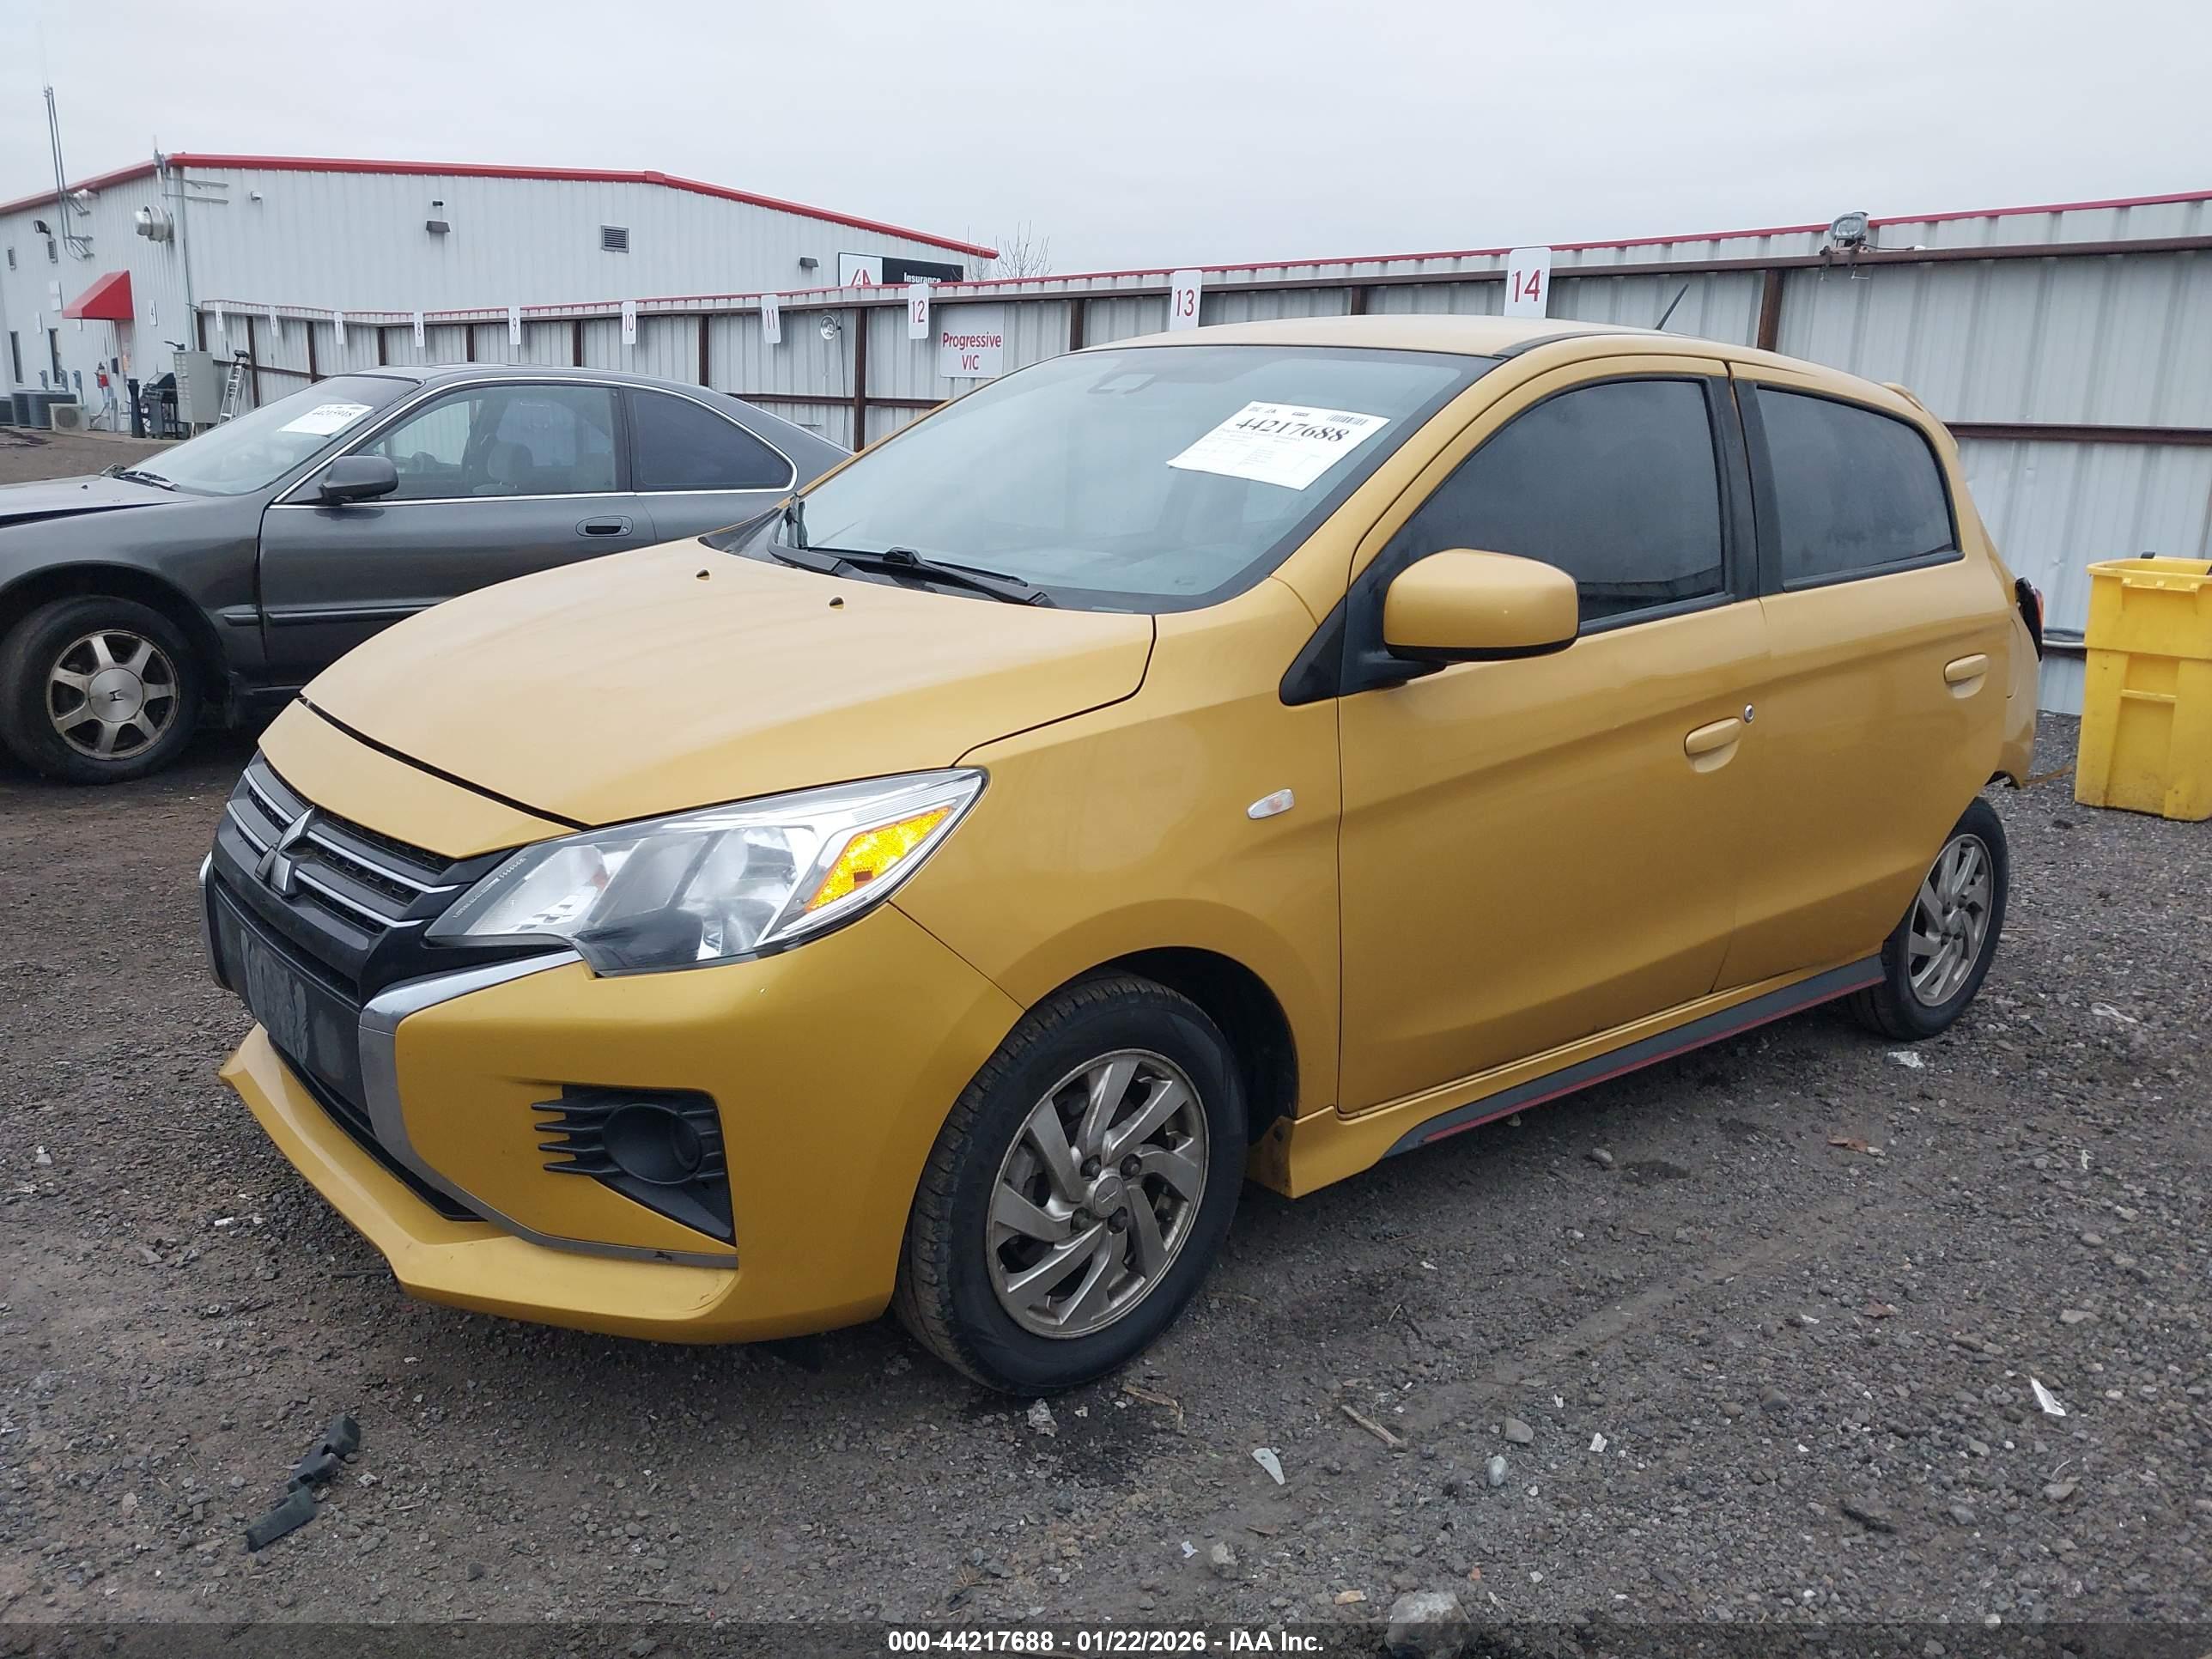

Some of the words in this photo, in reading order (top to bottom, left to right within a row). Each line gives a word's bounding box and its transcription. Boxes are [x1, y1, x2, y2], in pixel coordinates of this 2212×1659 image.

[904, 271, 942, 283] Insurance
[1513, 268, 1541, 303] 14
[911, 300, 925, 323] 12
[1175, 289, 1195, 317] 13
[512, 317, 517, 333] 9
[624, 313, 635, 331] 10
[766, 308, 775, 330] 11
[416, 322, 422, 337] 8
[942, 331, 1002, 350] Progressive
[962, 354, 980, 371] VIC
[1236, 417, 1350, 442] 44217688
